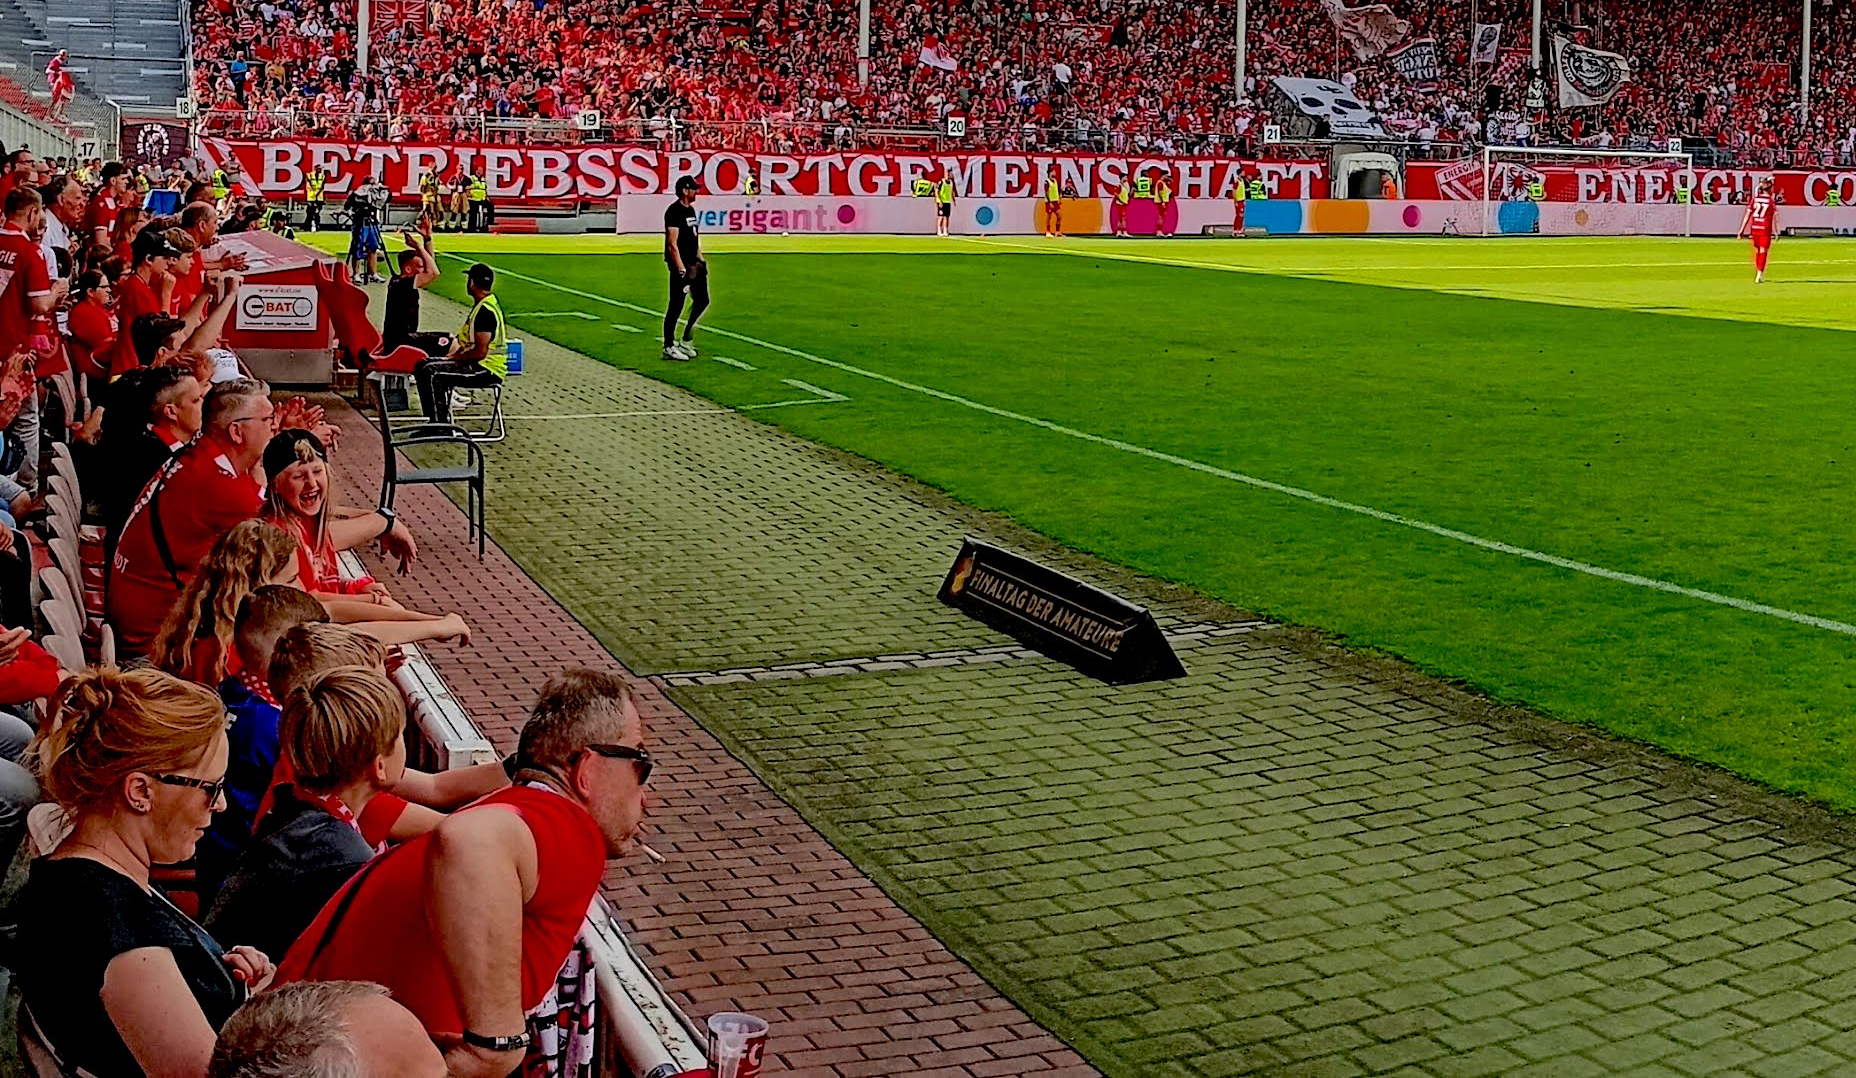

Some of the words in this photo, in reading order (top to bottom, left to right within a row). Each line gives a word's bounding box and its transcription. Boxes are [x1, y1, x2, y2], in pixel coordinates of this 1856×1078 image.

[179, 102, 189, 114] 18
[582, 113, 597, 126] 19
[950, 120, 964, 133] 20
[1267, 128, 1278, 140] 21
[81, 142, 94, 156] 17
[1671, 141, 1681, 151] 22
[258, 141, 1323, 202] BETRIEBSSPORTGEMEINSCHAFT
[1753, 203, 1768, 218] 27
[266, 302, 292, 313] BAT
[970, 569, 1027, 609] FINALTAG
[1025, 593, 1054, 624] DER
[1050, 606, 1124, 652] AMATEURE
